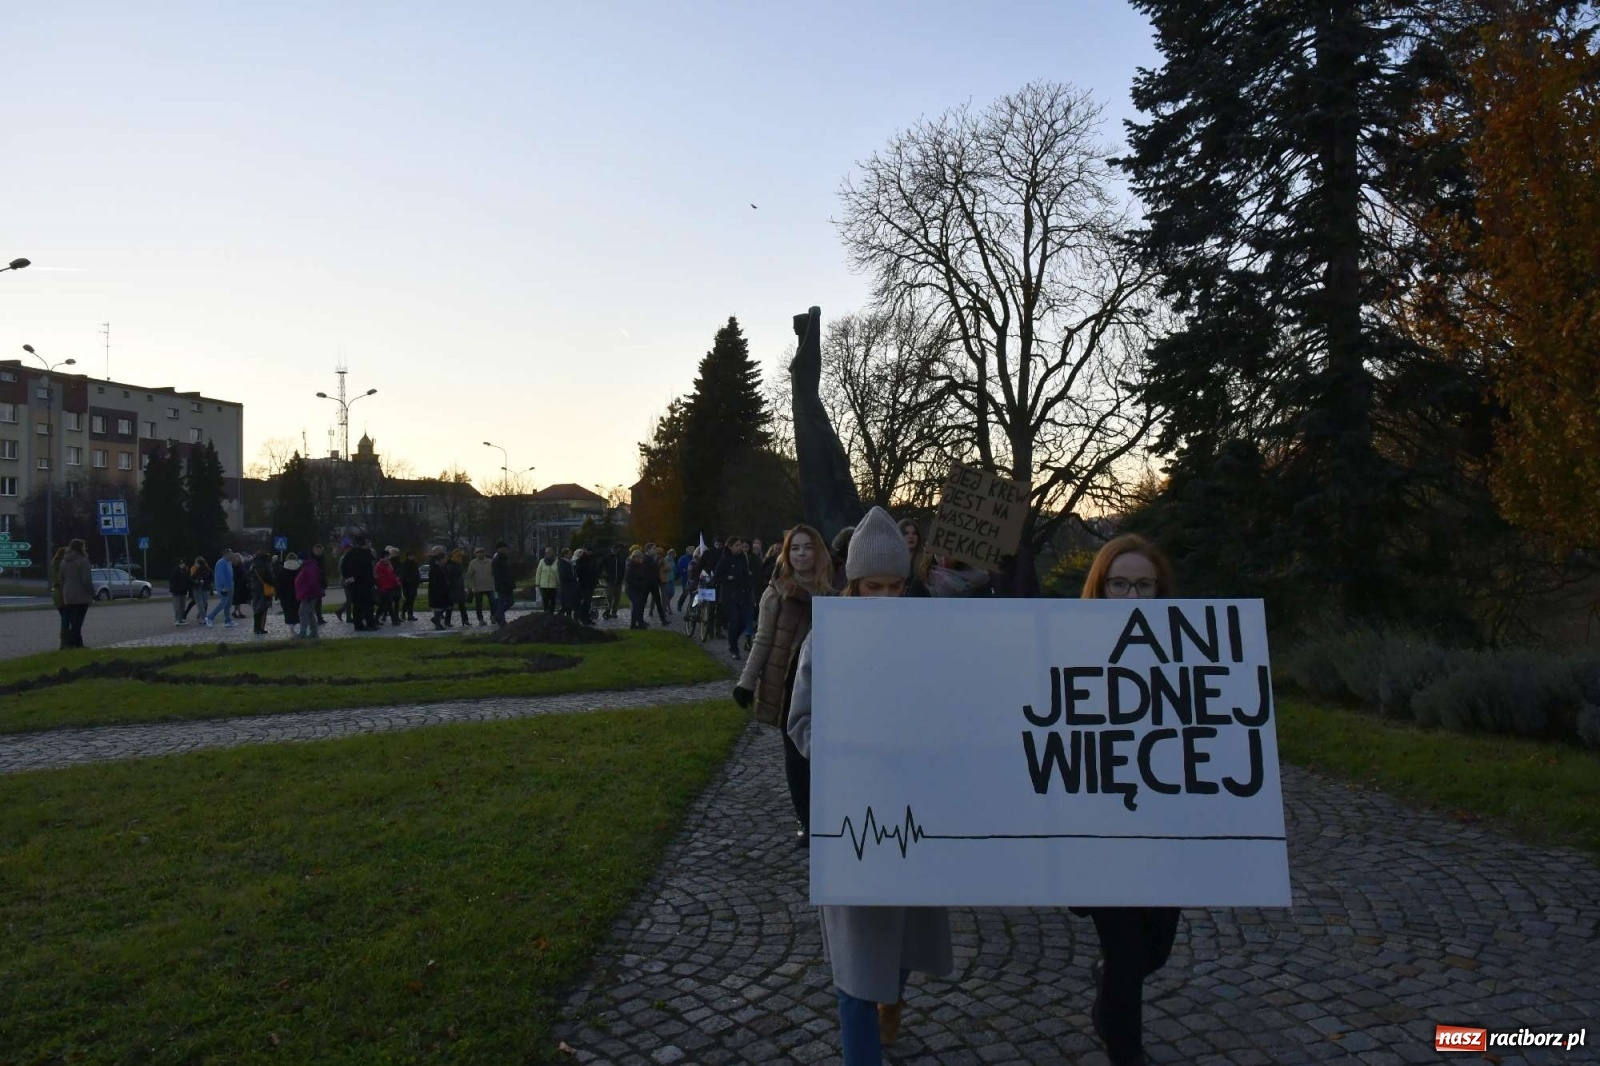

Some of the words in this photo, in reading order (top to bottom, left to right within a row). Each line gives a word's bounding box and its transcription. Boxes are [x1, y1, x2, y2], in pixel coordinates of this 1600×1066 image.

[944, 487, 985, 511] JEST
[992, 503, 1008, 519] NA
[950, 464, 982, 490] JEJ
[988, 480, 1027, 504] KREW
[939, 510, 999, 538] WASZYCH
[932, 527, 1001, 562] RĘKACH
[1108, 605, 1243, 664] ANI
[1022, 665, 1270, 727] JEDNEJ
[1022, 727, 1264, 811] WIĘCEJ
